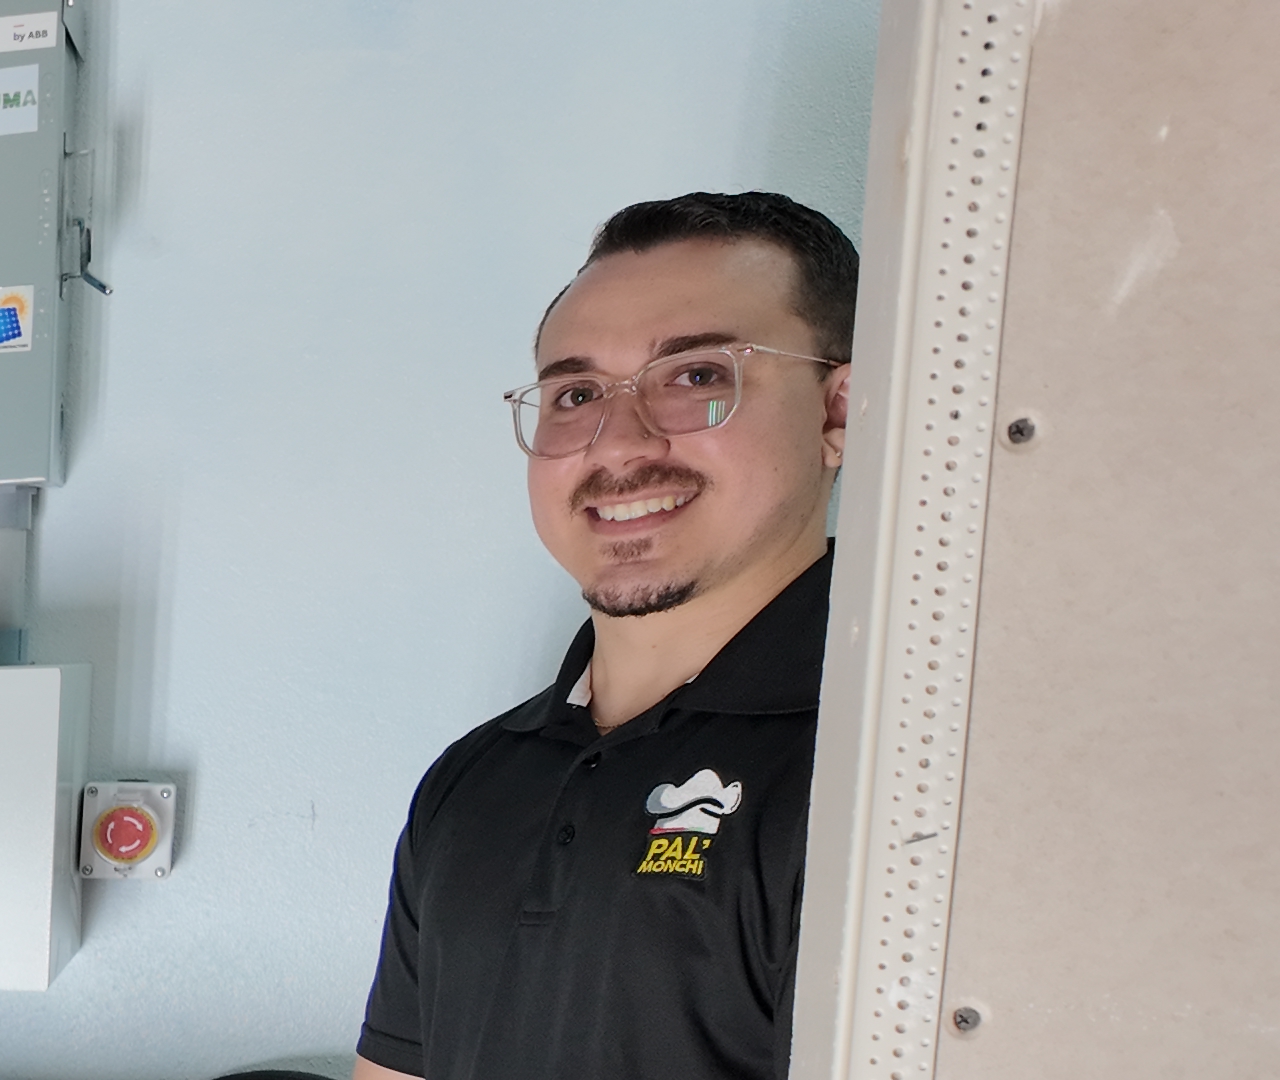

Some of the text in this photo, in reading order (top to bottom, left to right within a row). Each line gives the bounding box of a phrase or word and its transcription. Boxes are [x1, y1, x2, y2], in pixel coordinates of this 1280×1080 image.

[13, 30, 48, 42] by ABB
[637, 860, 705, 875] MONCHI
